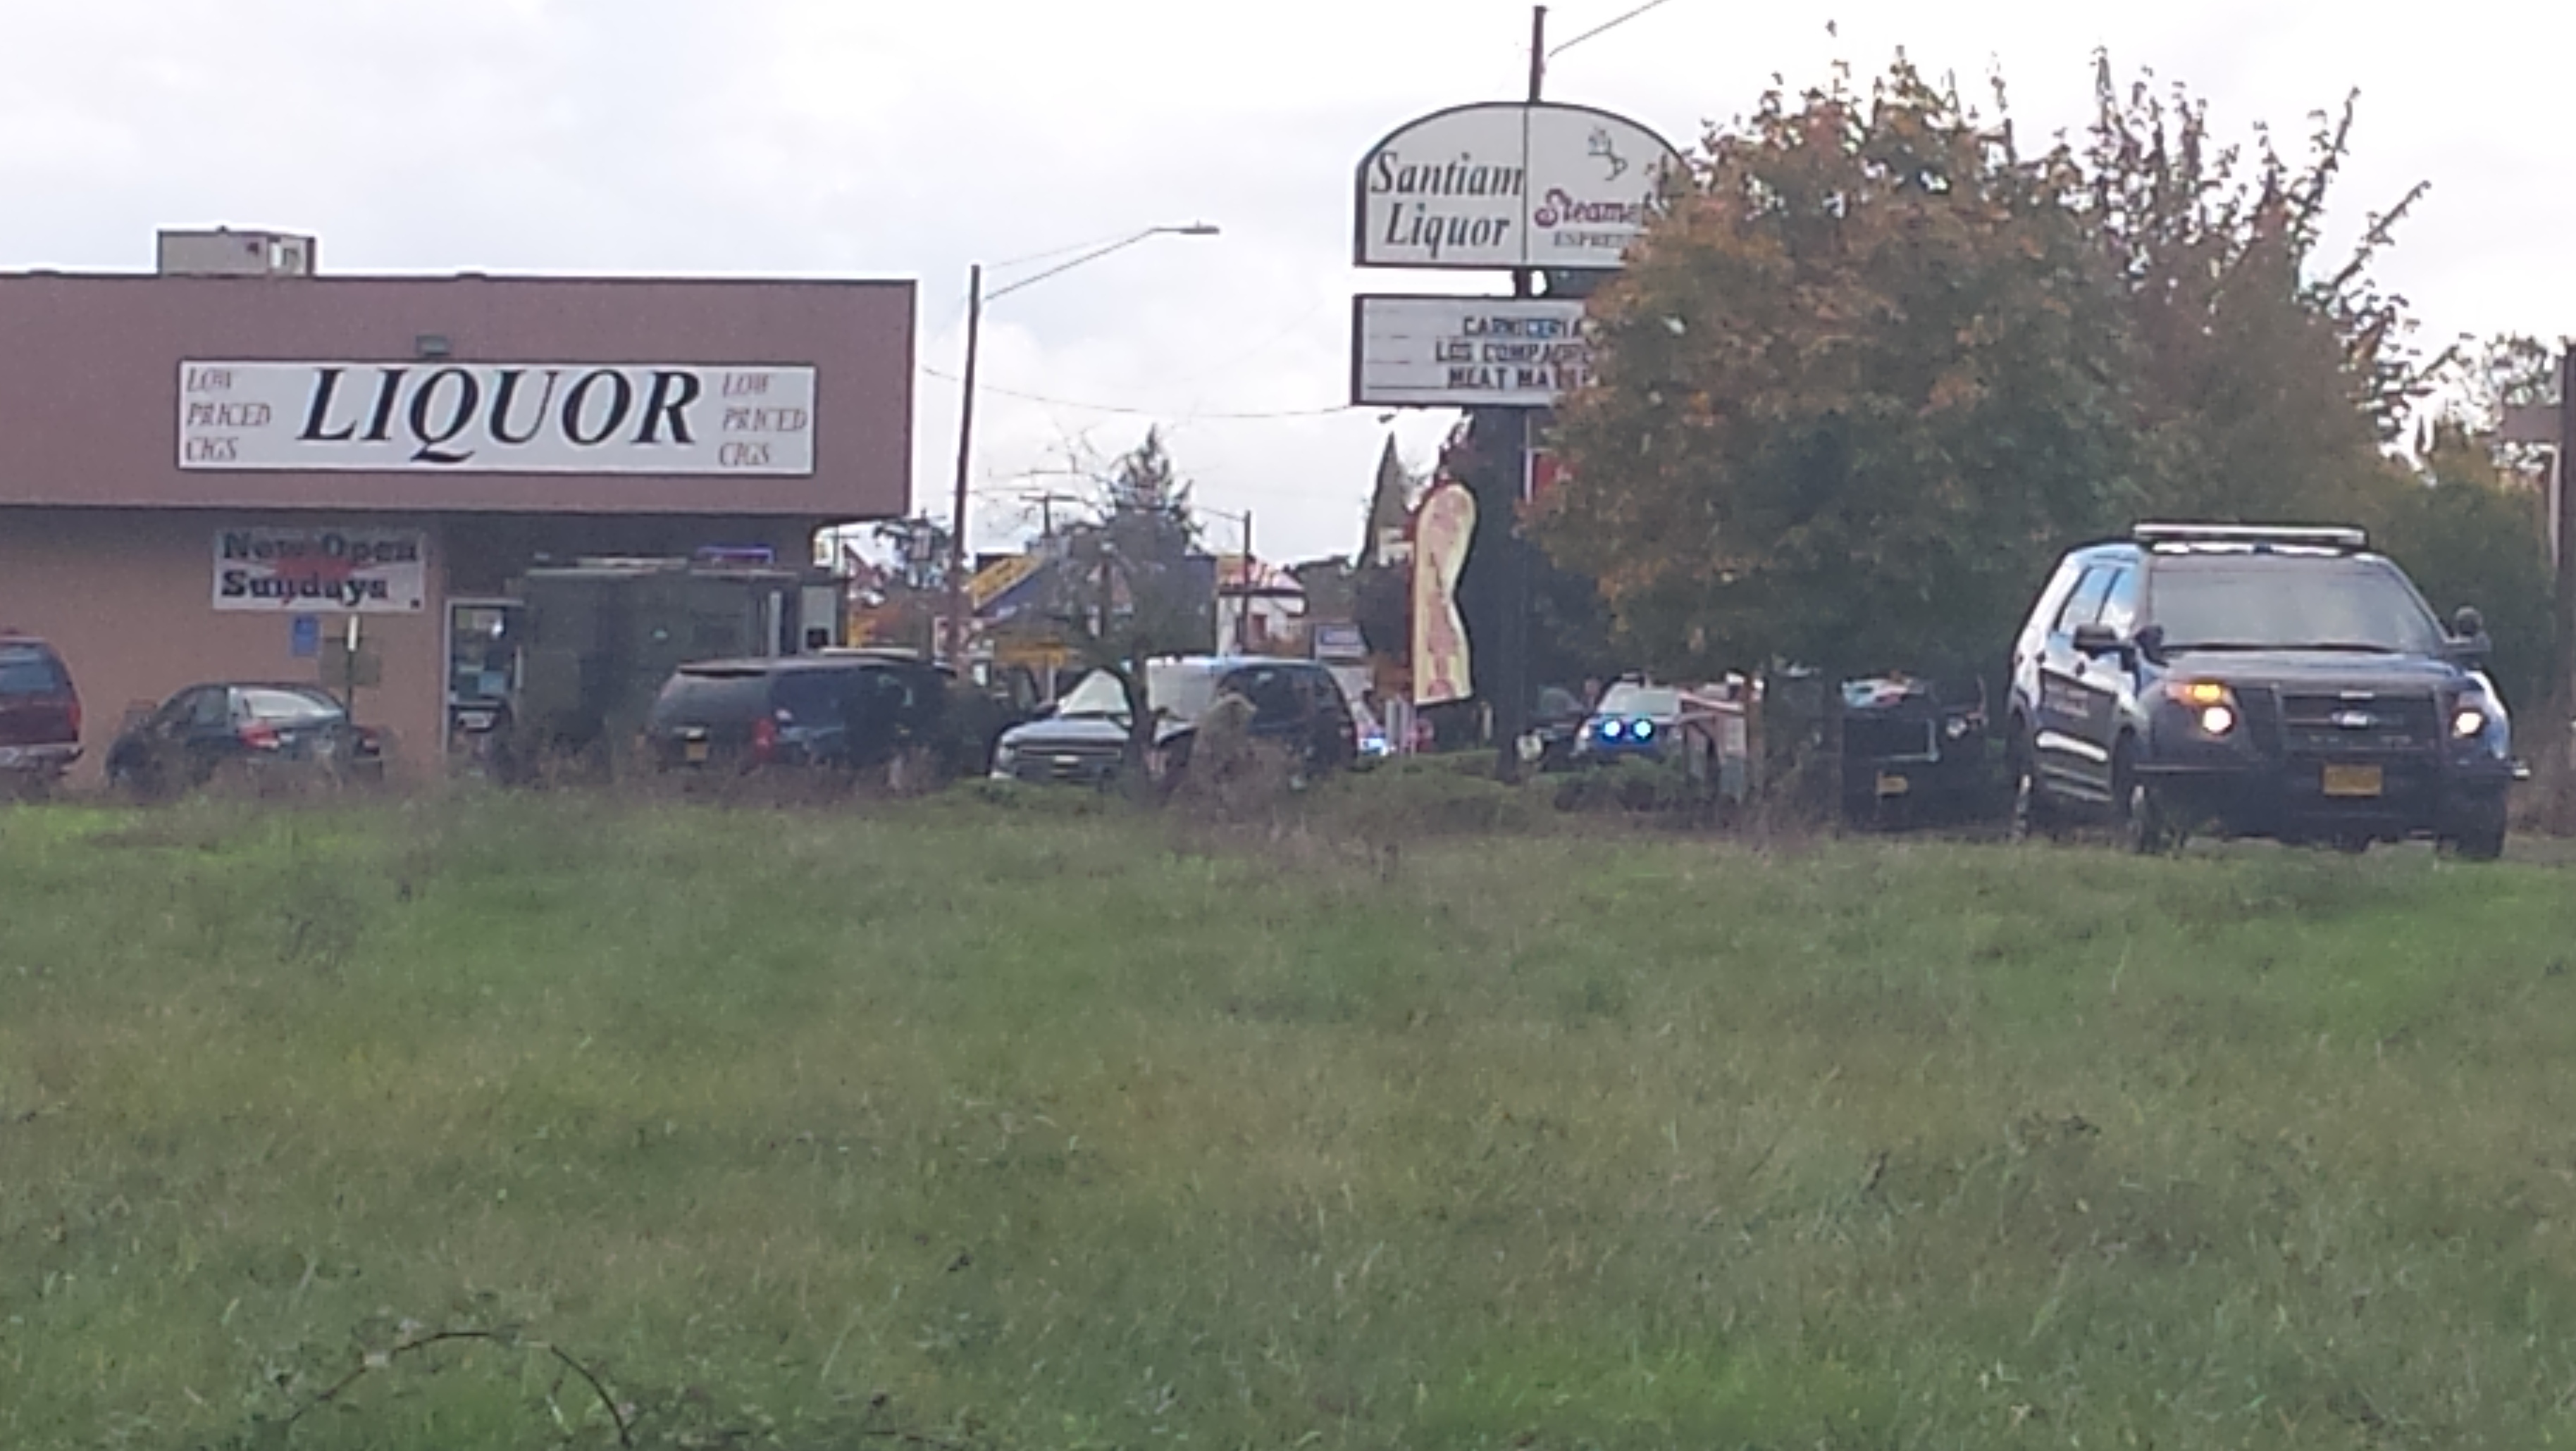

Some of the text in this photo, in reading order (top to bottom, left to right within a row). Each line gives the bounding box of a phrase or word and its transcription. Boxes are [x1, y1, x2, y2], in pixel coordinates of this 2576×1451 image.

[1370, 151, 1524, 197] Santiam
[1385, 201, 1511, 259] Liquor
[186, 366, 233, 392] LOW
[722, 372, 774, 398] LOW
[1448, 366, 1508, 390] MEAT
[186, 402, 271, 427] PRICED
[295, 366, 700, 463] LIQUOR
[722, 406, 809, 433] PRICED
[185, 436, 240, 462] CIGS
[718, 442, 771, 467] CIGS
[223, 532, 416, 562] Now Open
[221, 568, 388, 607] Sundays
